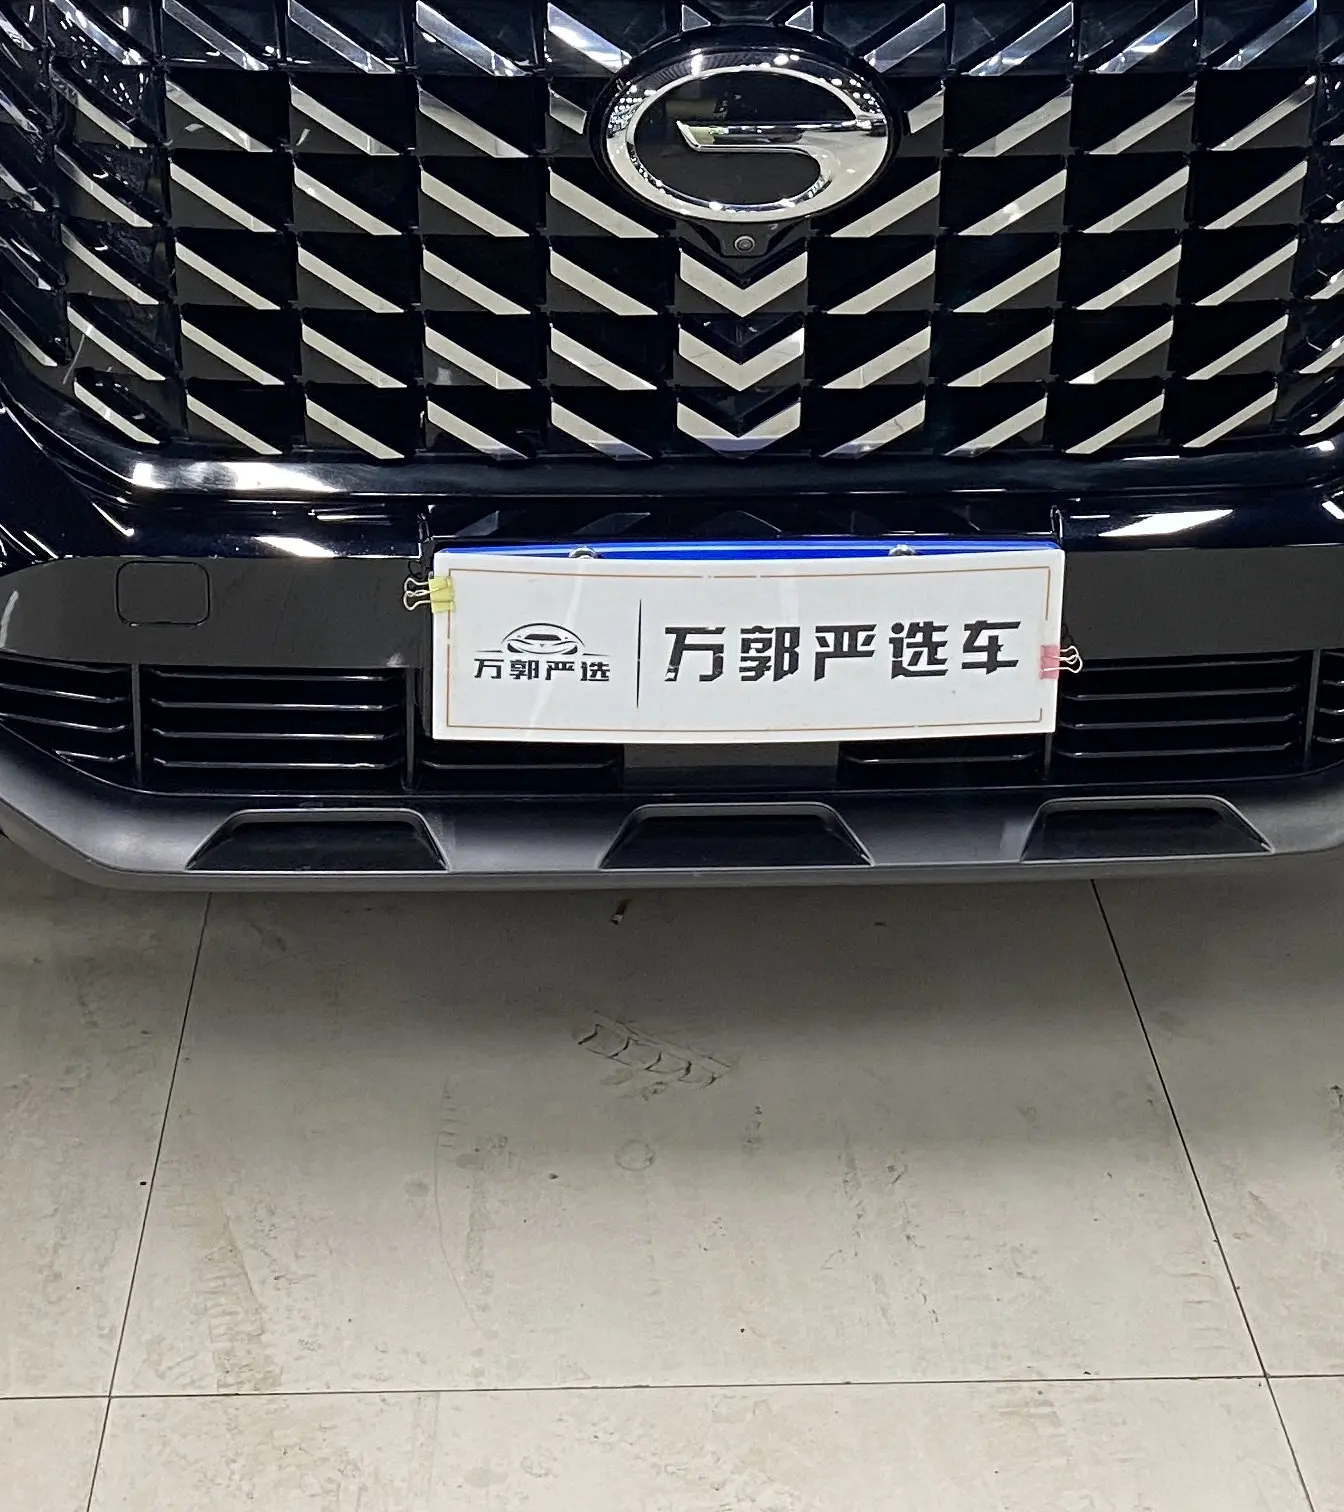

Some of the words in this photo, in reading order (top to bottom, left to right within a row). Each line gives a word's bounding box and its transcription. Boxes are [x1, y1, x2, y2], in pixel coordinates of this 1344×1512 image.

[473, 659, 611, 683] 万郭严选
[664, 619, 1022, 683] 万郭严选车
